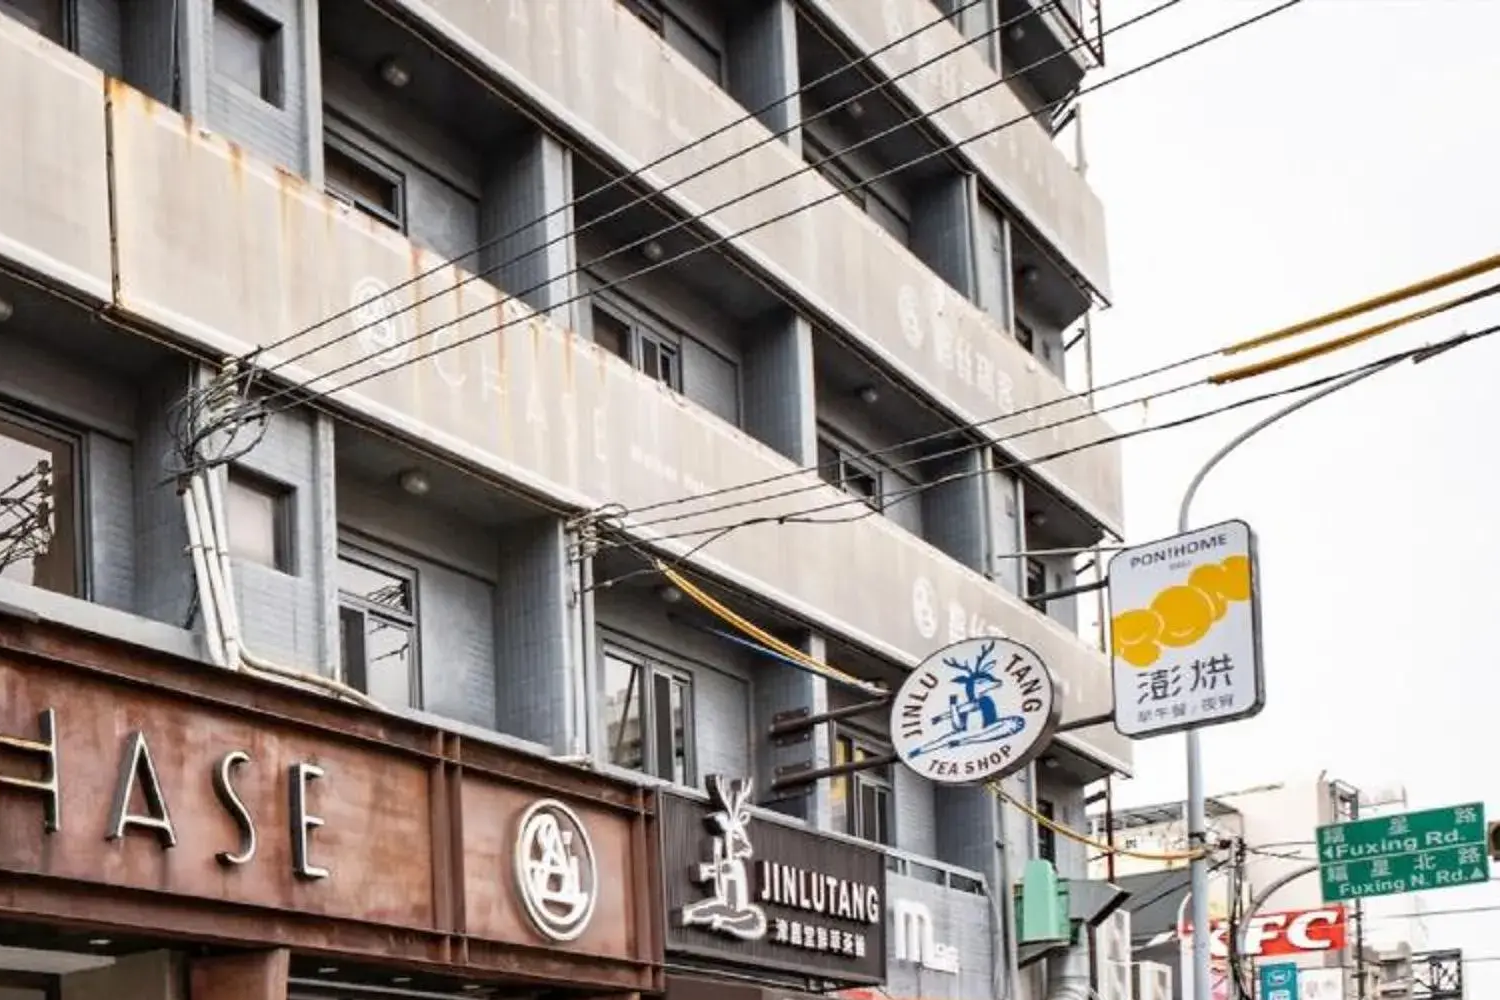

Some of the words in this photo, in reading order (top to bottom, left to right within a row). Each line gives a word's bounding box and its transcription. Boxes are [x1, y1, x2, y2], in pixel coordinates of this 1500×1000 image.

[901, 671, 939, 739] JINLU
[1004, 653, 1043, 713] TANG
[928, 759, 960, 775] TEA
[964, 744, 1013, 774] SHOP
[1335, 837, 1418, 858] Fuxing
[1424, 823, 1466, 846] Rd.
[761, 860, 879, 923] JINLUTANG
[1339, 878, 1406, 897] Fuxing
[1435, 862, 1468, 884] Rd.
